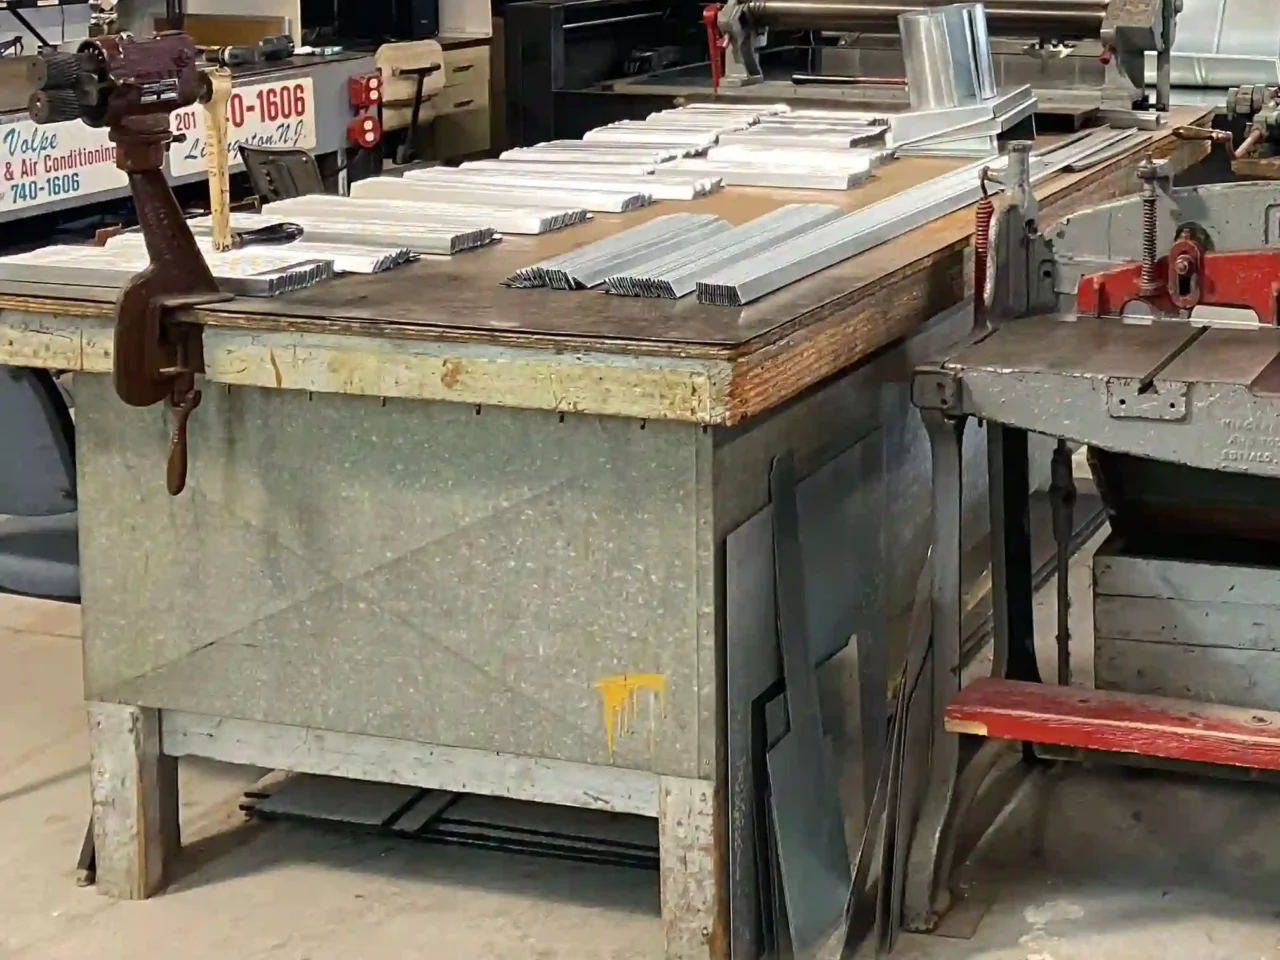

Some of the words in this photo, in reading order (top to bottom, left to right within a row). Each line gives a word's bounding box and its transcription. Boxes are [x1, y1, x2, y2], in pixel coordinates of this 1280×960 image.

[175, 111, 197, 132] 201
[227, 84, 306, 128] 0-1606
[3, 127, 58, 159] Volpe
[4, 161, 14, 181] &
[20, 158, 38, 179] Air
[44, 144, 117, 173] Conditioning
[11, 172, 80, 204] 740-1606
